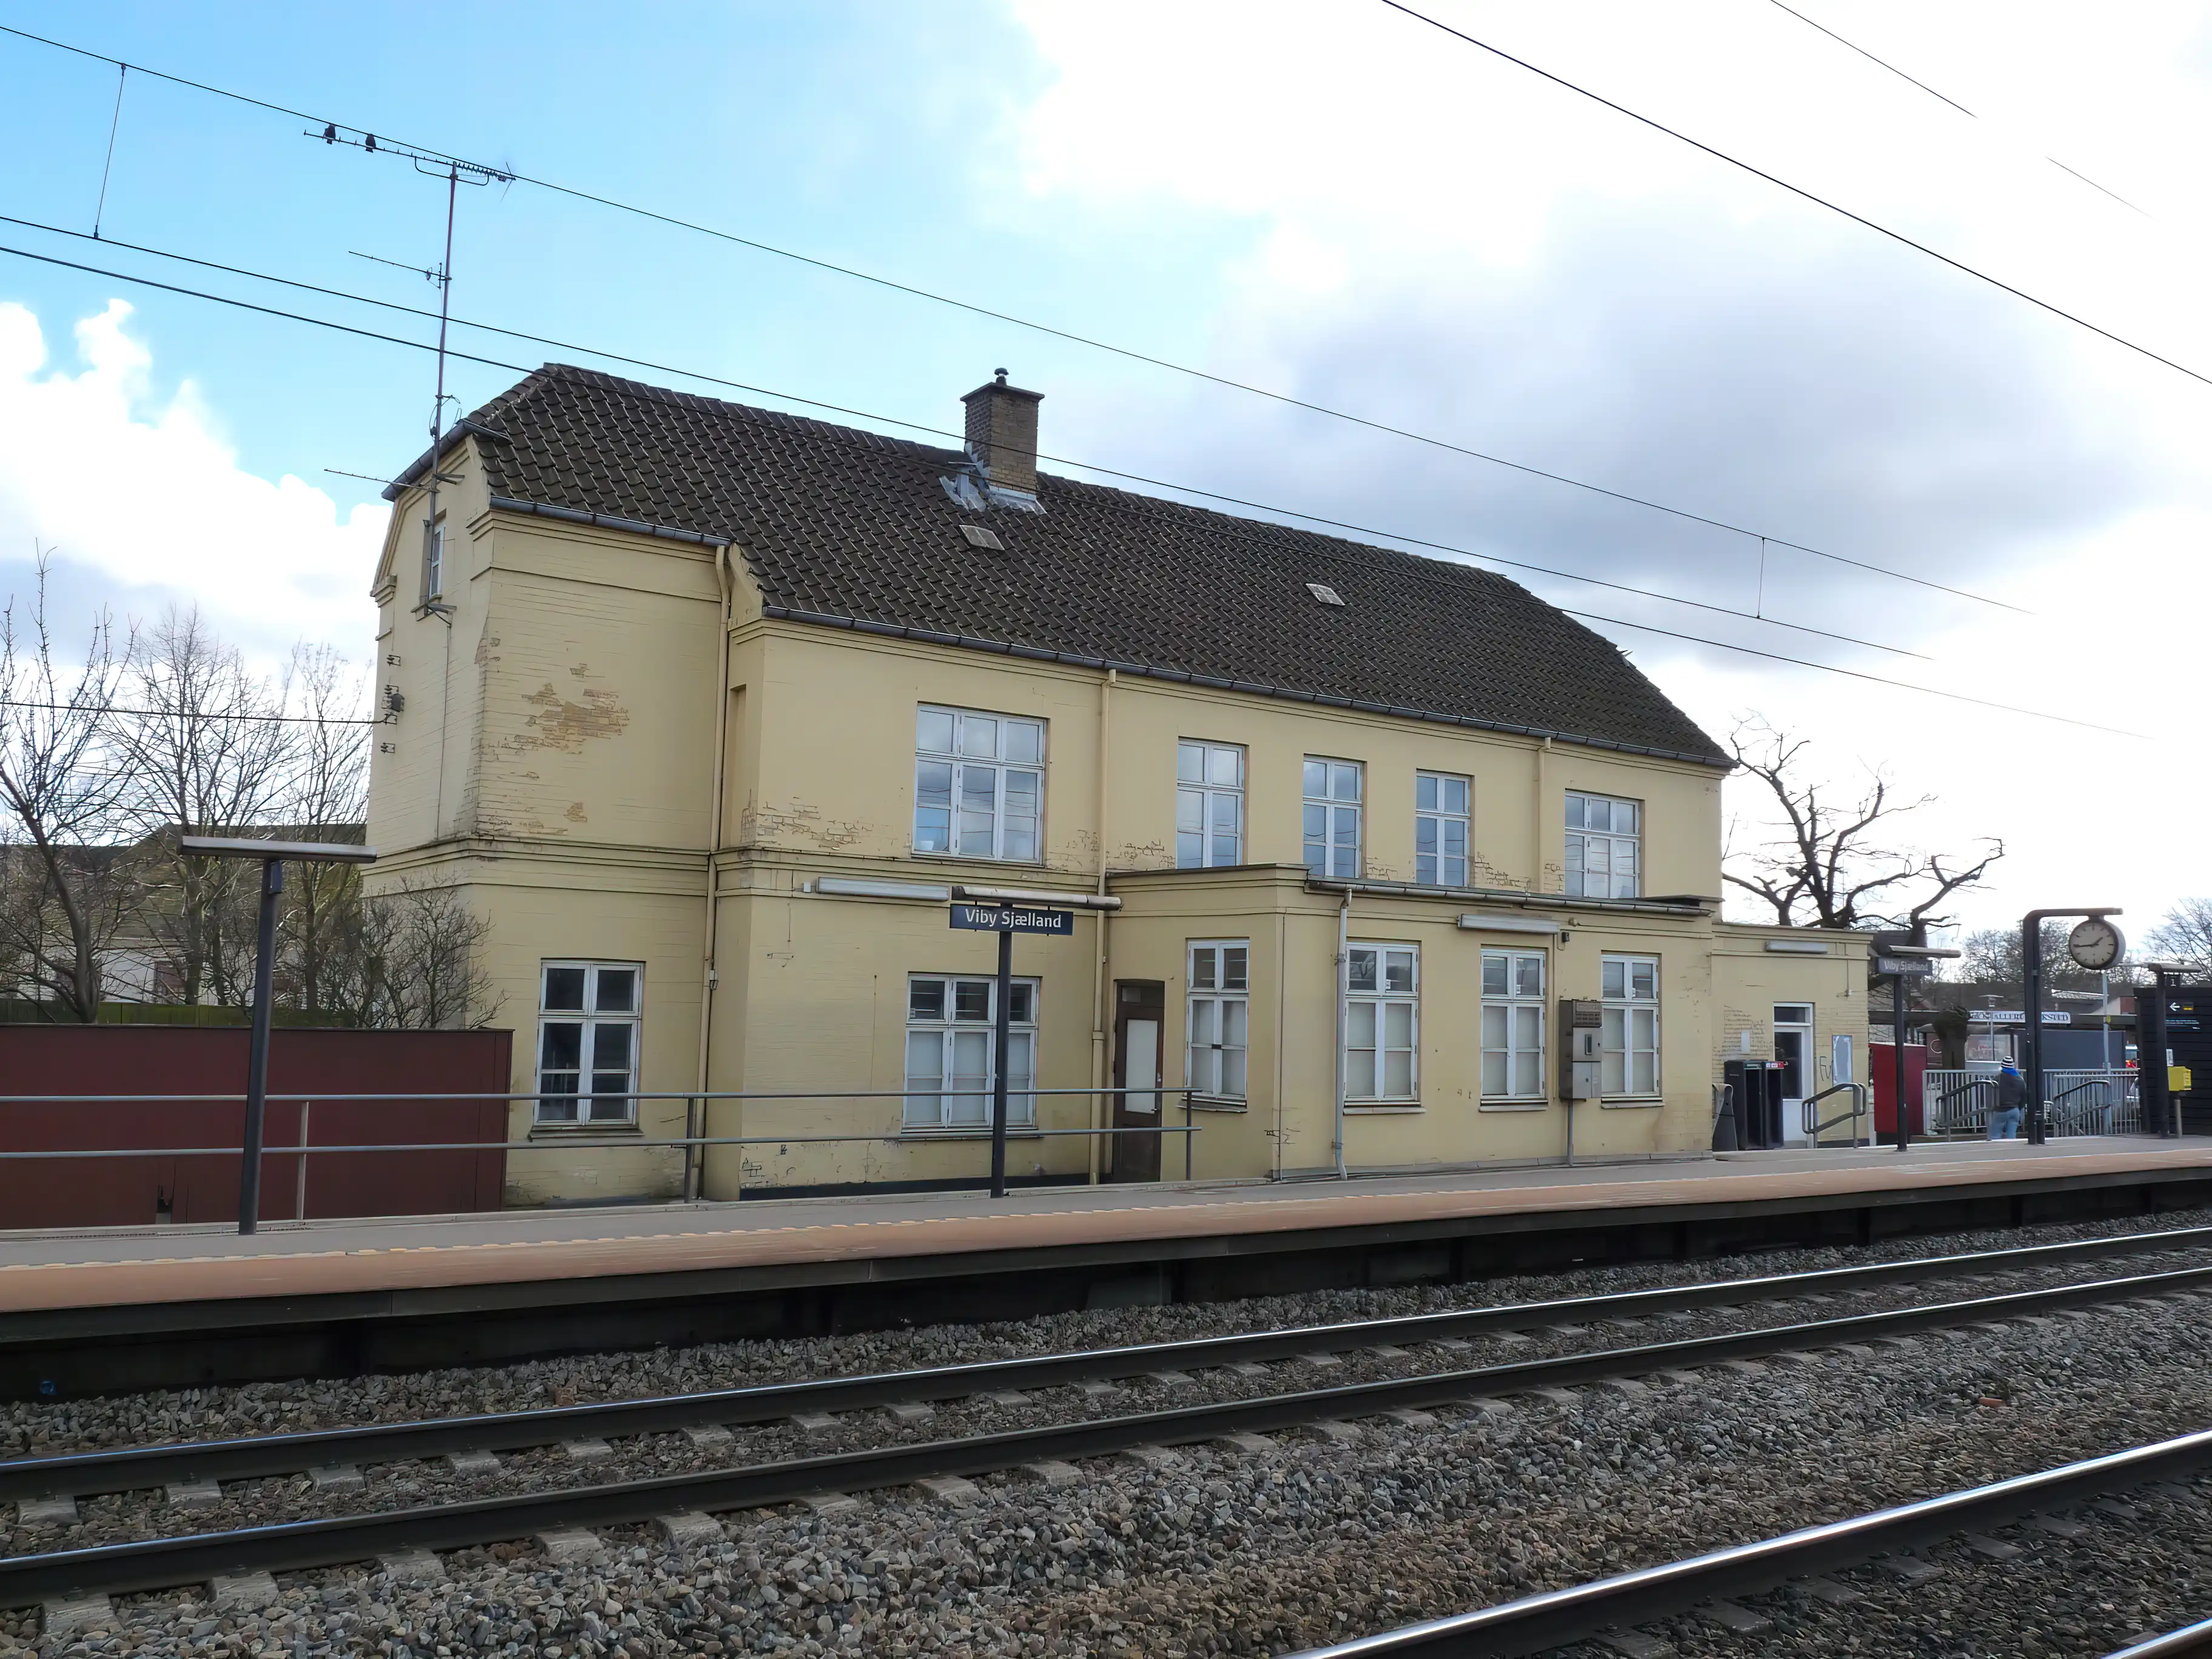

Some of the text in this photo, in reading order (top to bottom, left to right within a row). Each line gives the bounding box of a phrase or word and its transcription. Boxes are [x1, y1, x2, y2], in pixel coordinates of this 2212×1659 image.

[965, 908, 1061, 928] Viby Sjælland
[1884, 960, 1899, 972] Viby
